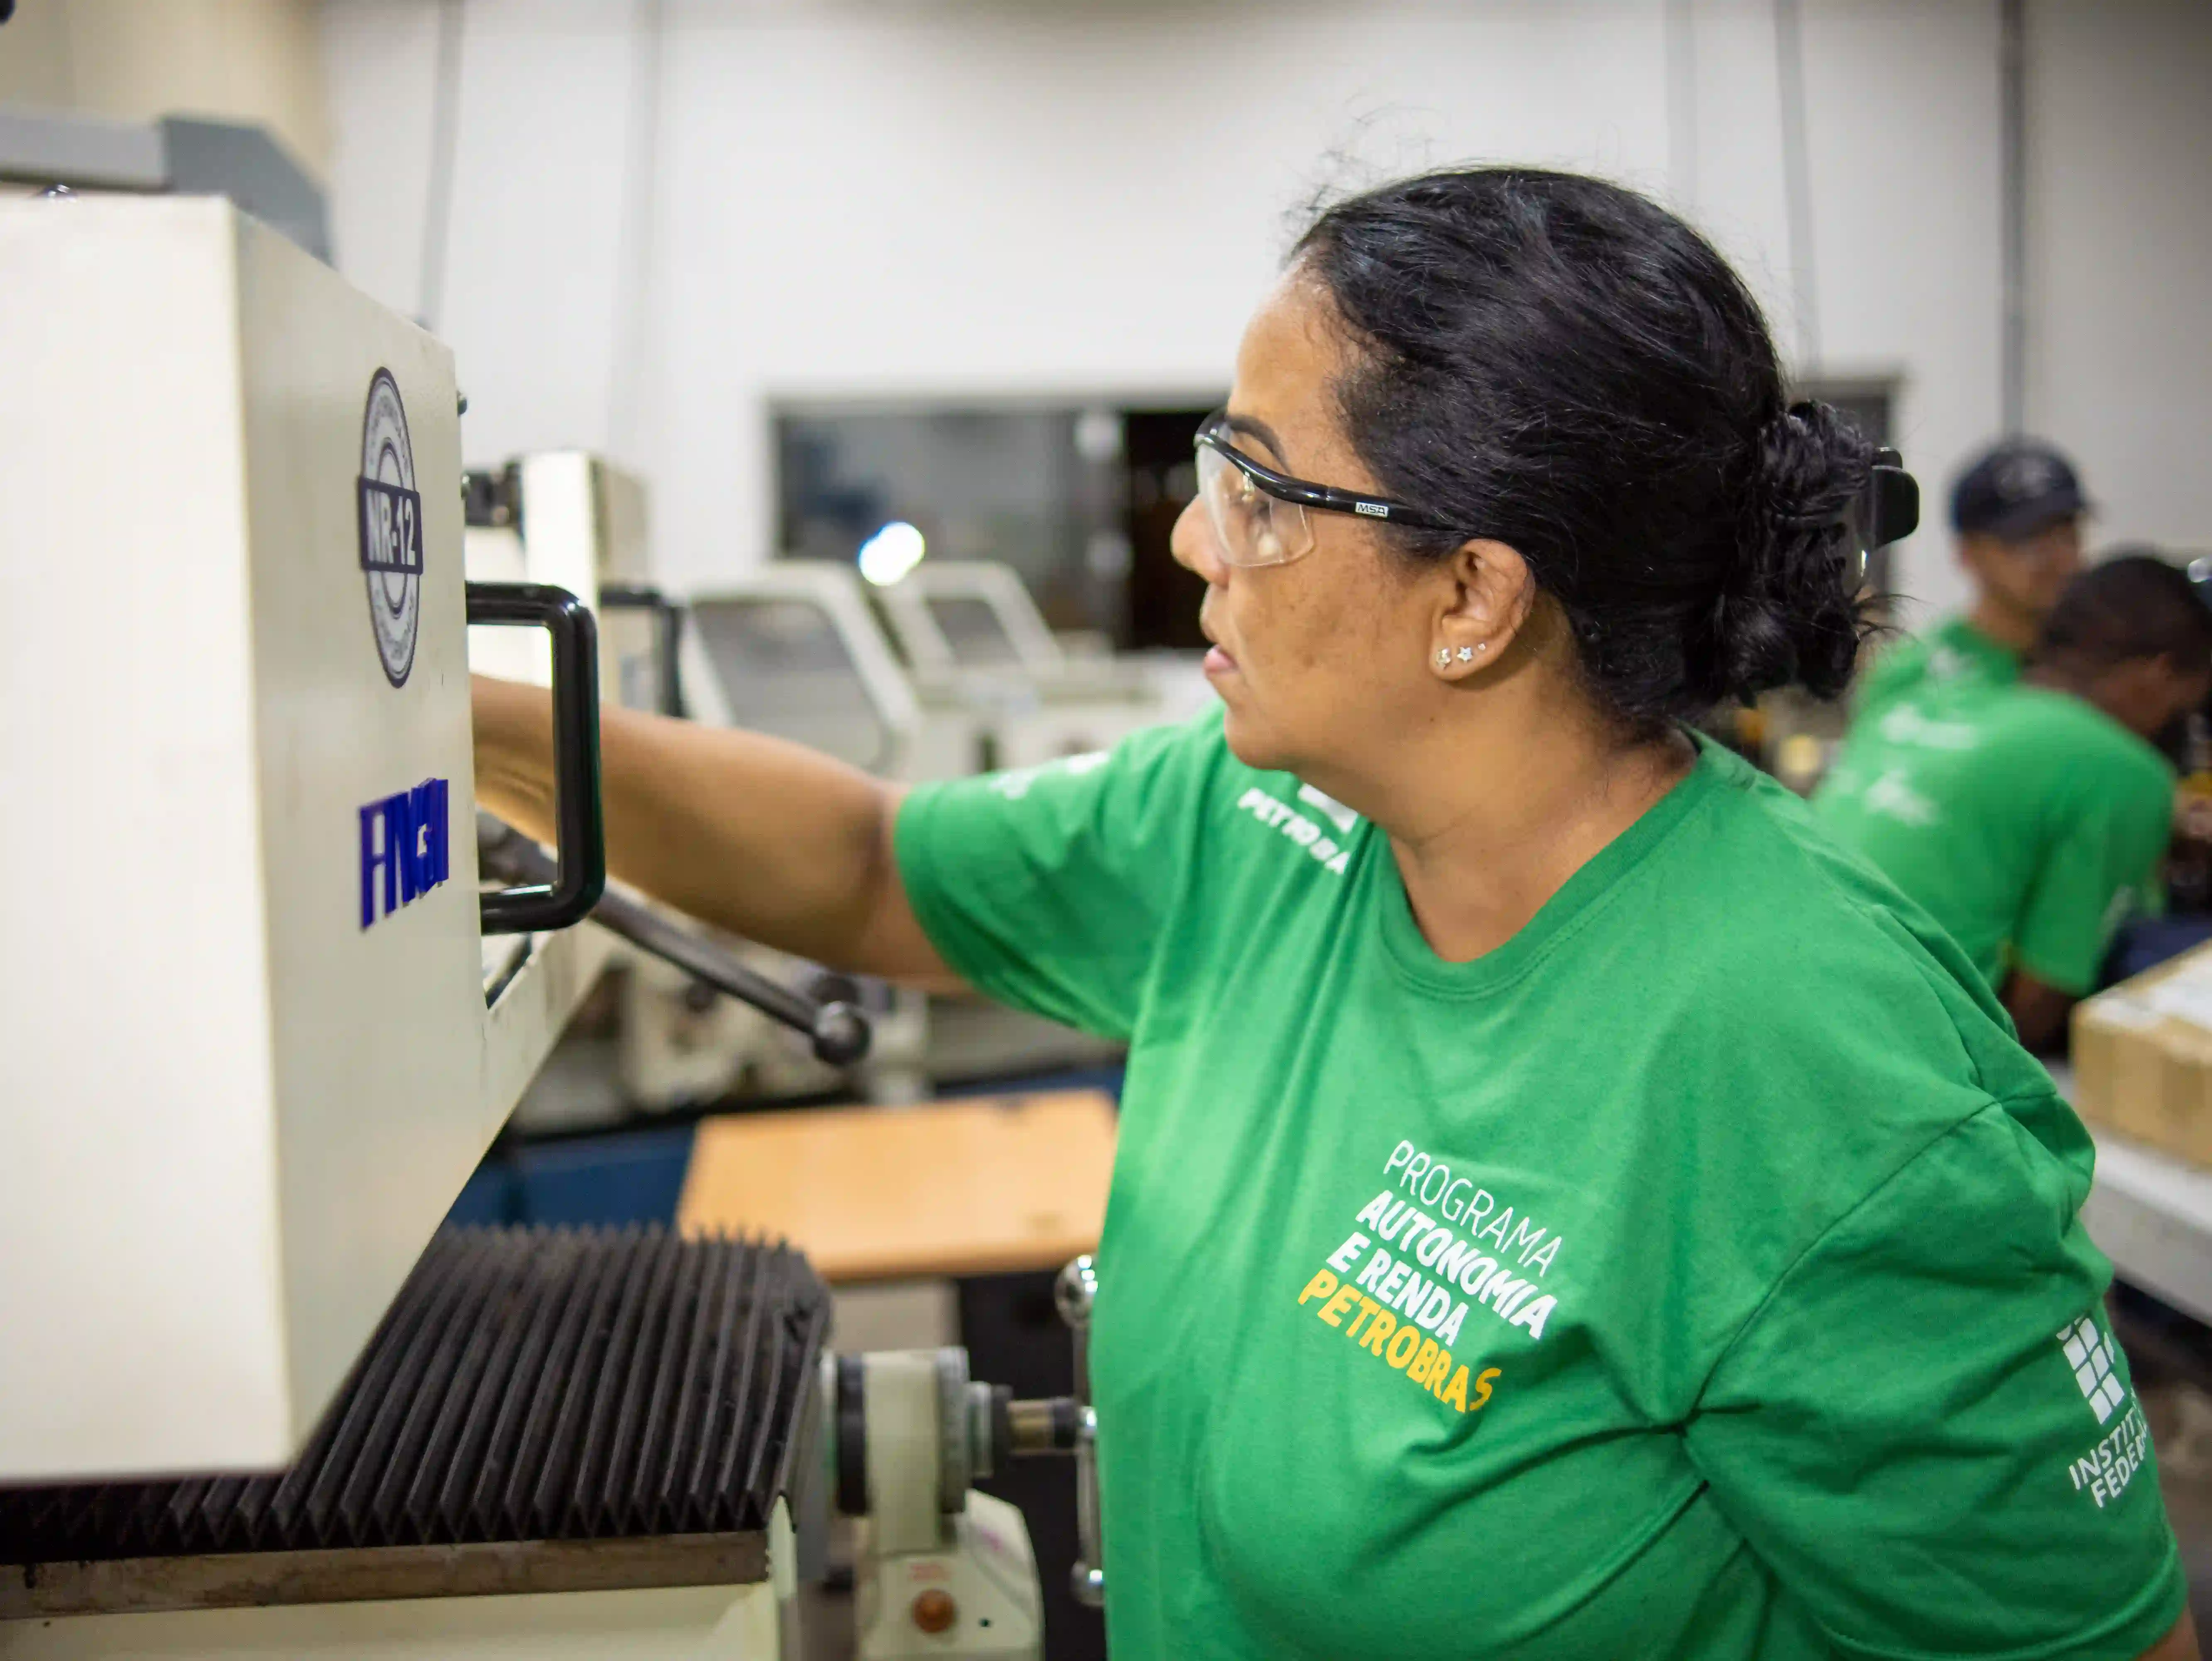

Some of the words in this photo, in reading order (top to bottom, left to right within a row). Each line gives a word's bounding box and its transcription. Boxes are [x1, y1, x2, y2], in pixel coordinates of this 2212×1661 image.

[366, 488, 416, 566] NR-12
[1358, 505, 1385, 515] MSA
[1355, 1189, 1559, 1340] AUTONOMIA
[1383, 1139, 1563, 1278] PROGRAMA
[1297, 1269, 1502, 1413] PETROBRAS
[1326, 1231, 1371, 1273] E
[1356, 1248, 1469, 1347] RENDA
